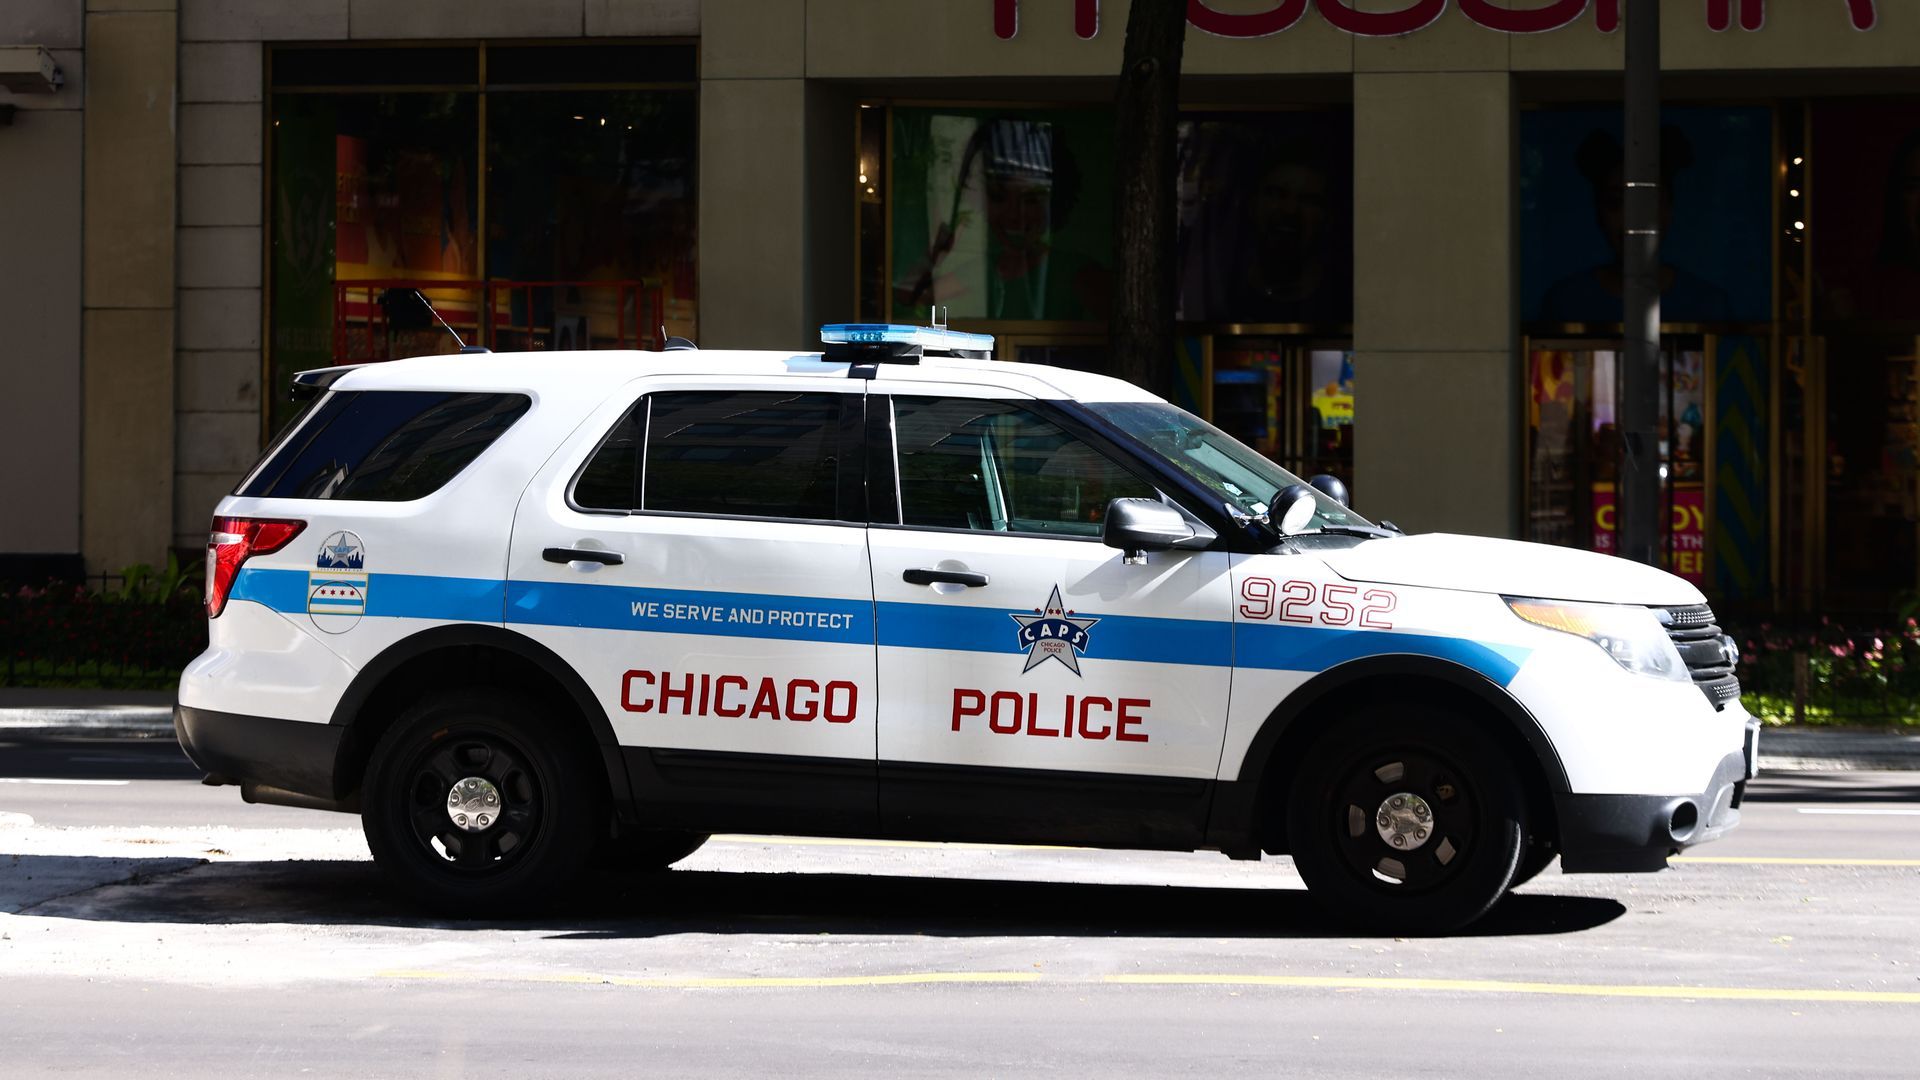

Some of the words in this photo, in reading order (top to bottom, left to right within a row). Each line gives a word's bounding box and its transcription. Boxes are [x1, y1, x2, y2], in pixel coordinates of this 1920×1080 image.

[631, 602, 659, 617] WE
[663, 604, 723, 622] SERVE
[728, 608, 763, 624] AND
[768, 610, 853, 629] PROTECT
[1240, 577, 1397, 629] 9252
[1024, 624, 1084, 643] CAPS
[621, 669, 857, 723] CHICAGO
[951, 688, 1151, 742] POLICE
